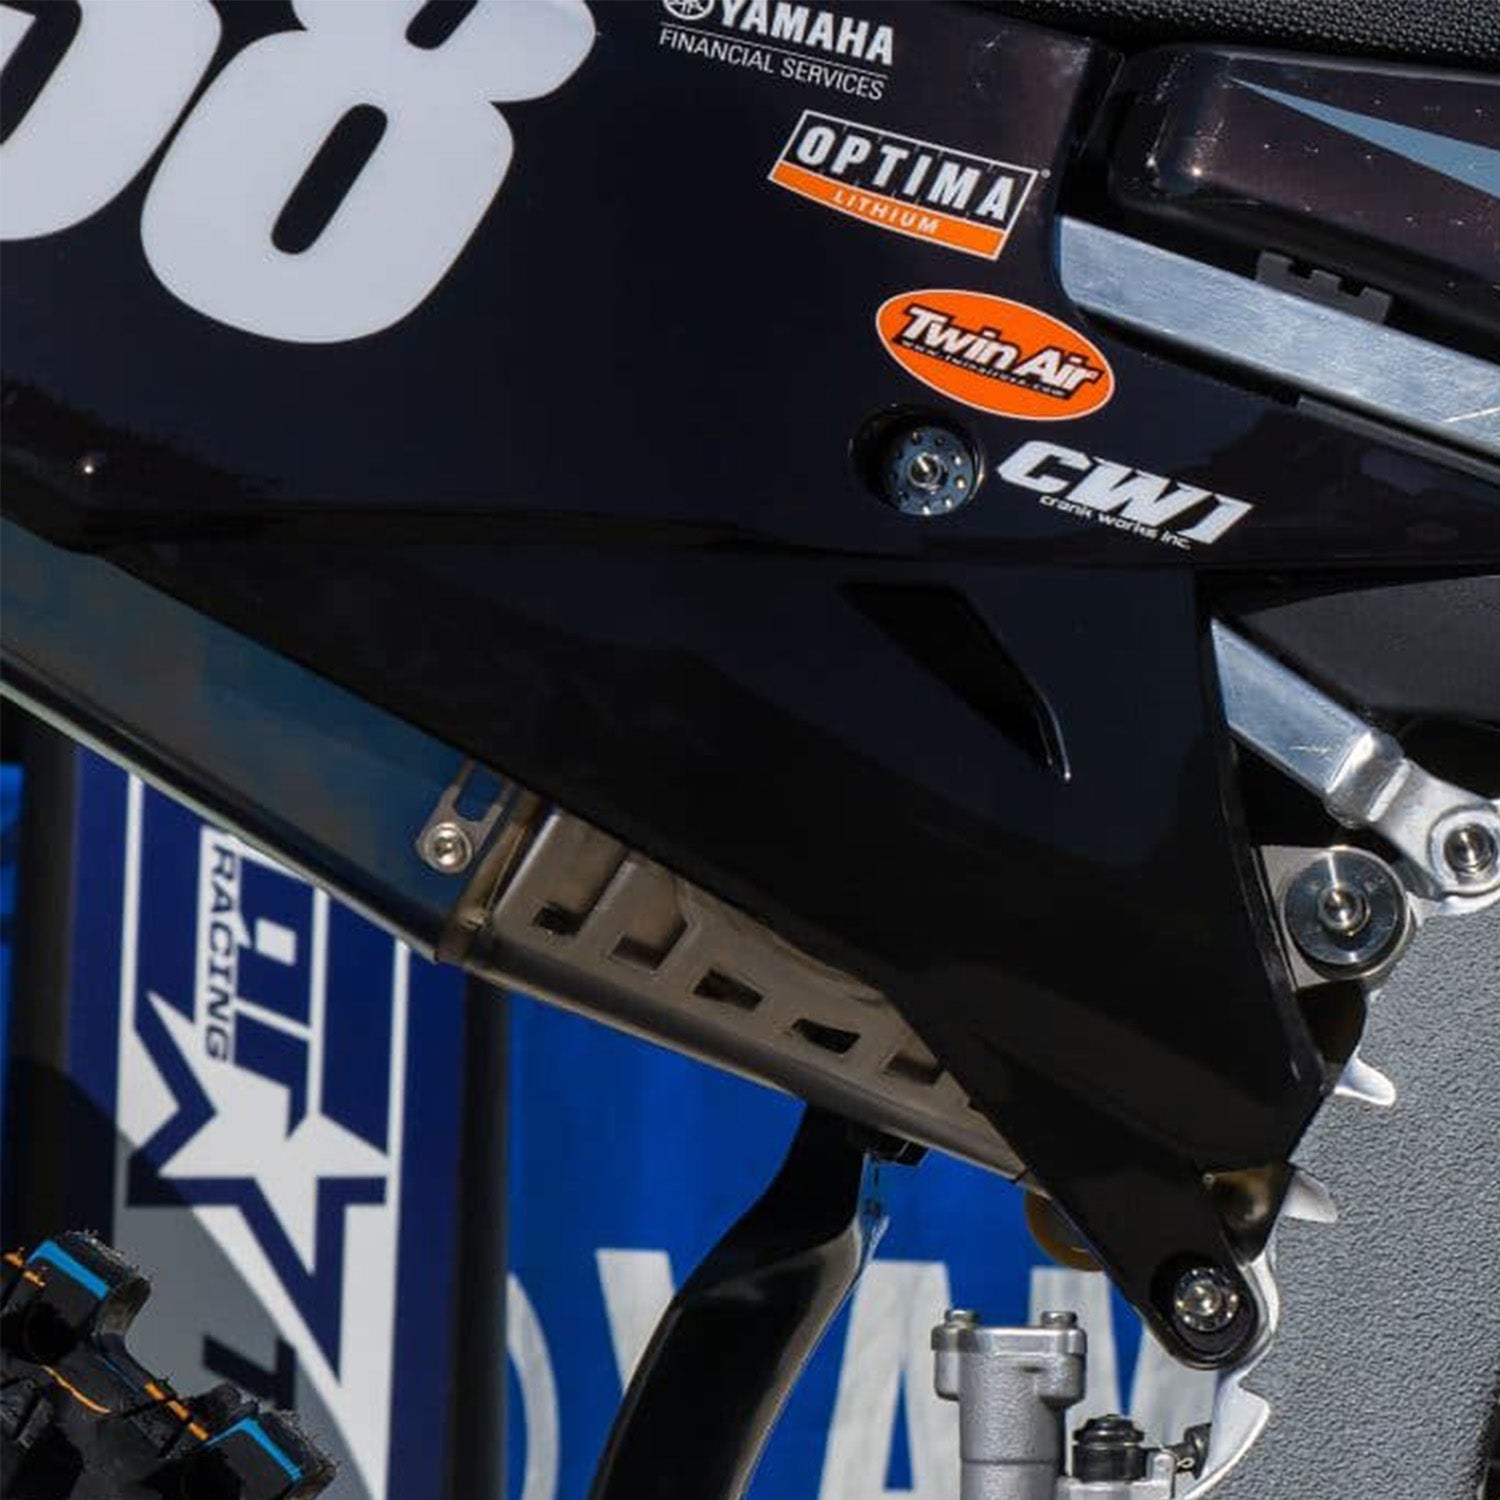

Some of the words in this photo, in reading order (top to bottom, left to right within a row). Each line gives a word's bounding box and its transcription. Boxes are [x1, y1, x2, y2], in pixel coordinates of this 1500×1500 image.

[659, 28, 774, 73] FINANCIAL
[780, 58, 884, 101] SERVICES
[721, 0, 894, 66] YAMAHA
[796, 125, 1014, 221] OPTIMA
[832, 188, 941, 235] LITHIUM
[901, 306, 1018, 372] Twin
[1013, 347, 1100, 392] Air
[1039, 495, 1093, 520] crank
[1098, 512, 1158, 541] works
[205, 842, 236, 1063] RACING
